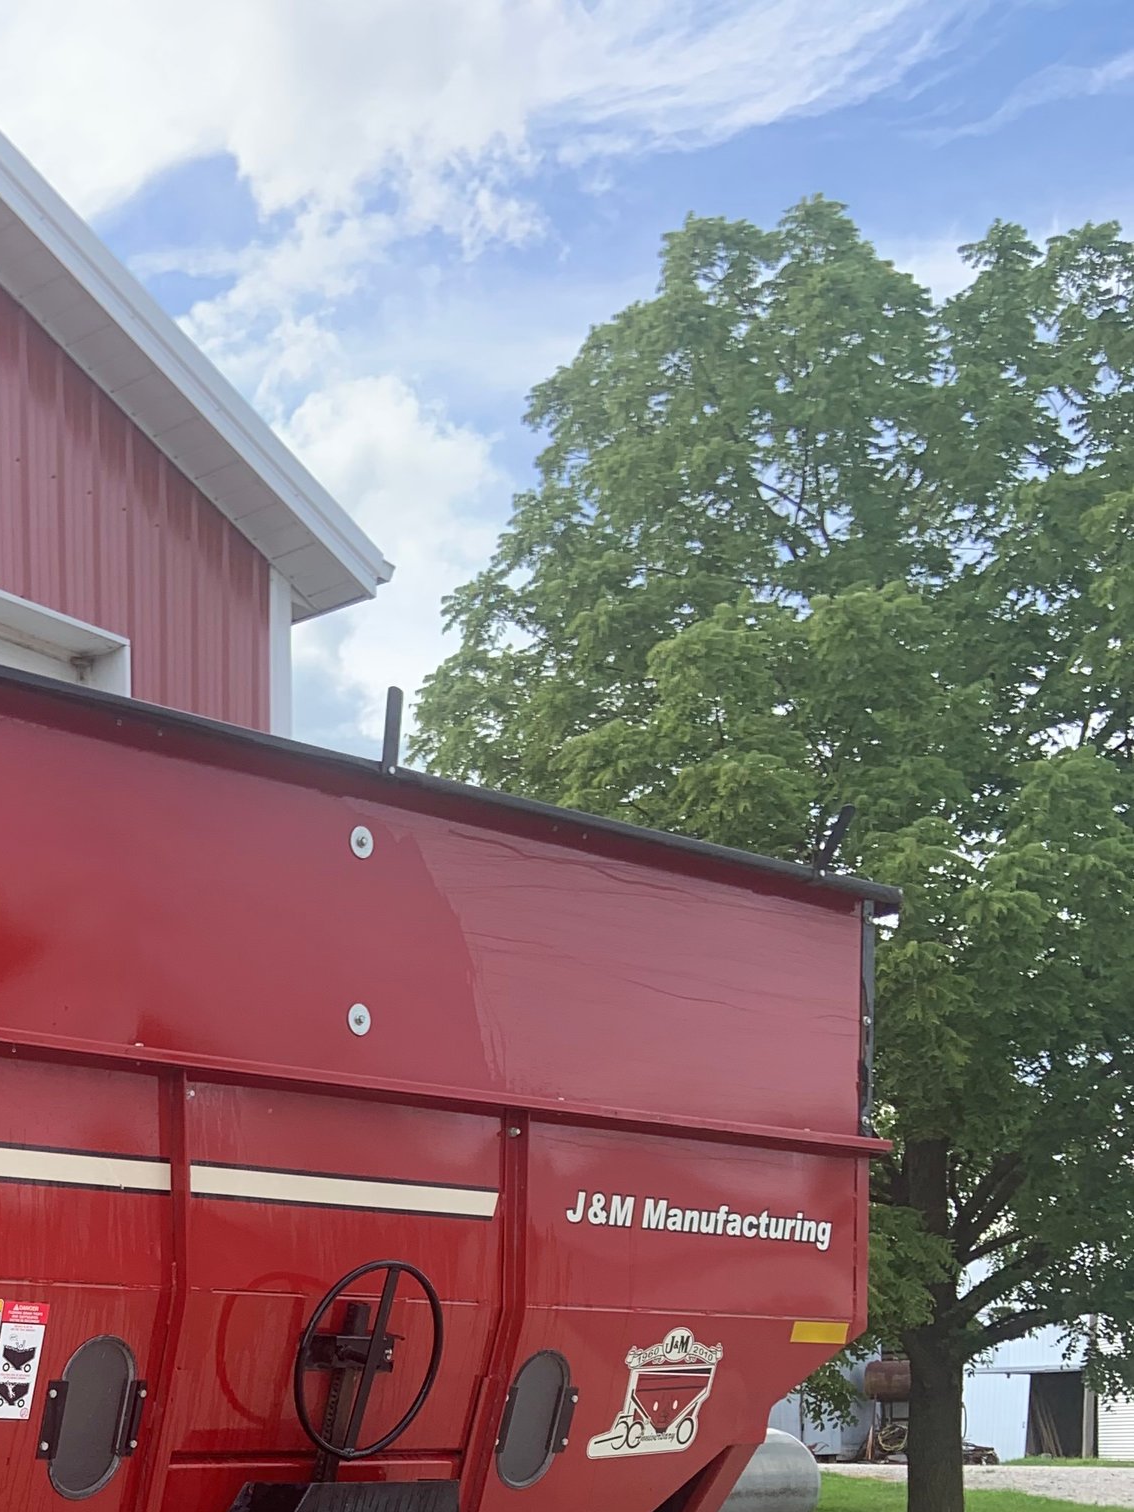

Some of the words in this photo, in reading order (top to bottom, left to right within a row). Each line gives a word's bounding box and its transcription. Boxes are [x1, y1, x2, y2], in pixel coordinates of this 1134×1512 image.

[566, 1190, 635, 1228] J&M
[641, 1198, 832, 1251] Manufacturing
[637, 1348, 659, 1363] 1960
[665, 1335, 691, 1354] J&M
[693, 1346, 714, 1362] 2010
